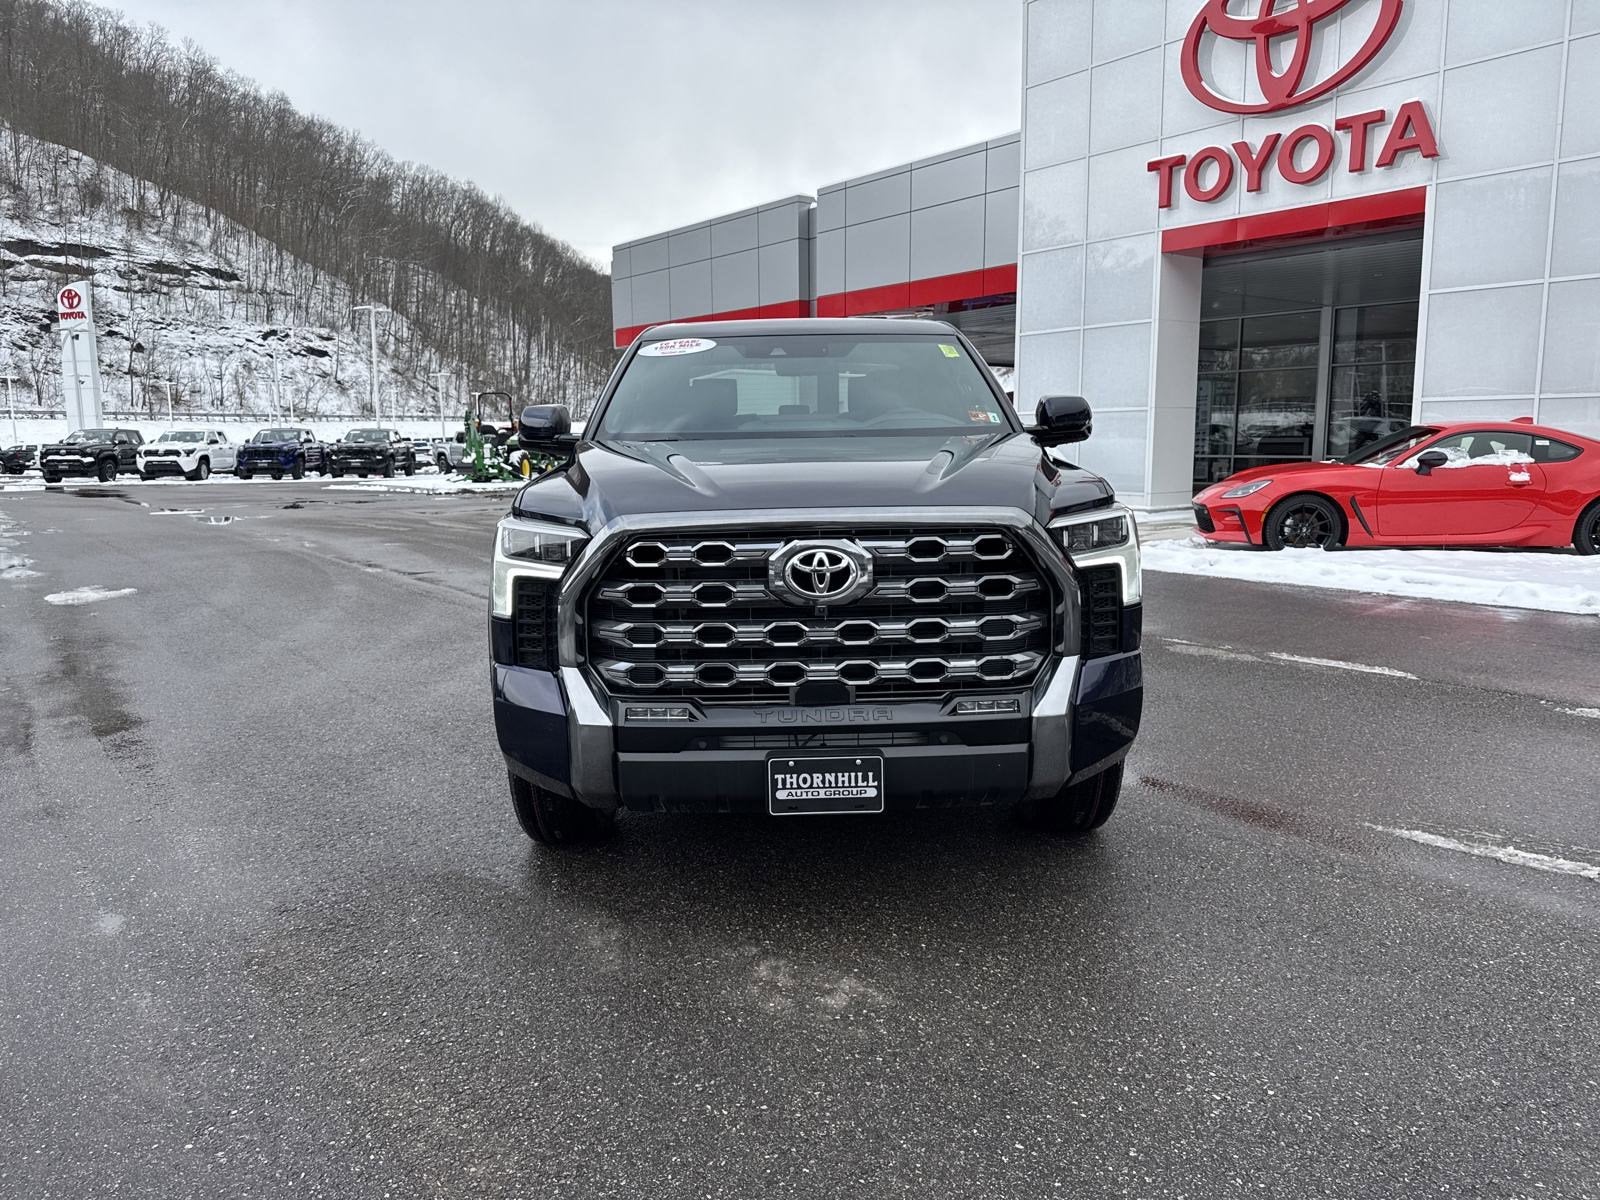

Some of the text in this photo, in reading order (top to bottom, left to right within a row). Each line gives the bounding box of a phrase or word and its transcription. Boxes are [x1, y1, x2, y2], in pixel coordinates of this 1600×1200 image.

[1147, 99, 1439, 209] TOYOTA
[59, 311, 87, 320] TOYOTA
[753, 707, 894, 723] TUNDRA
[774, 772, 878, 789] THORNHILL
[786, 789, 868, 798] AUTO GROUP
